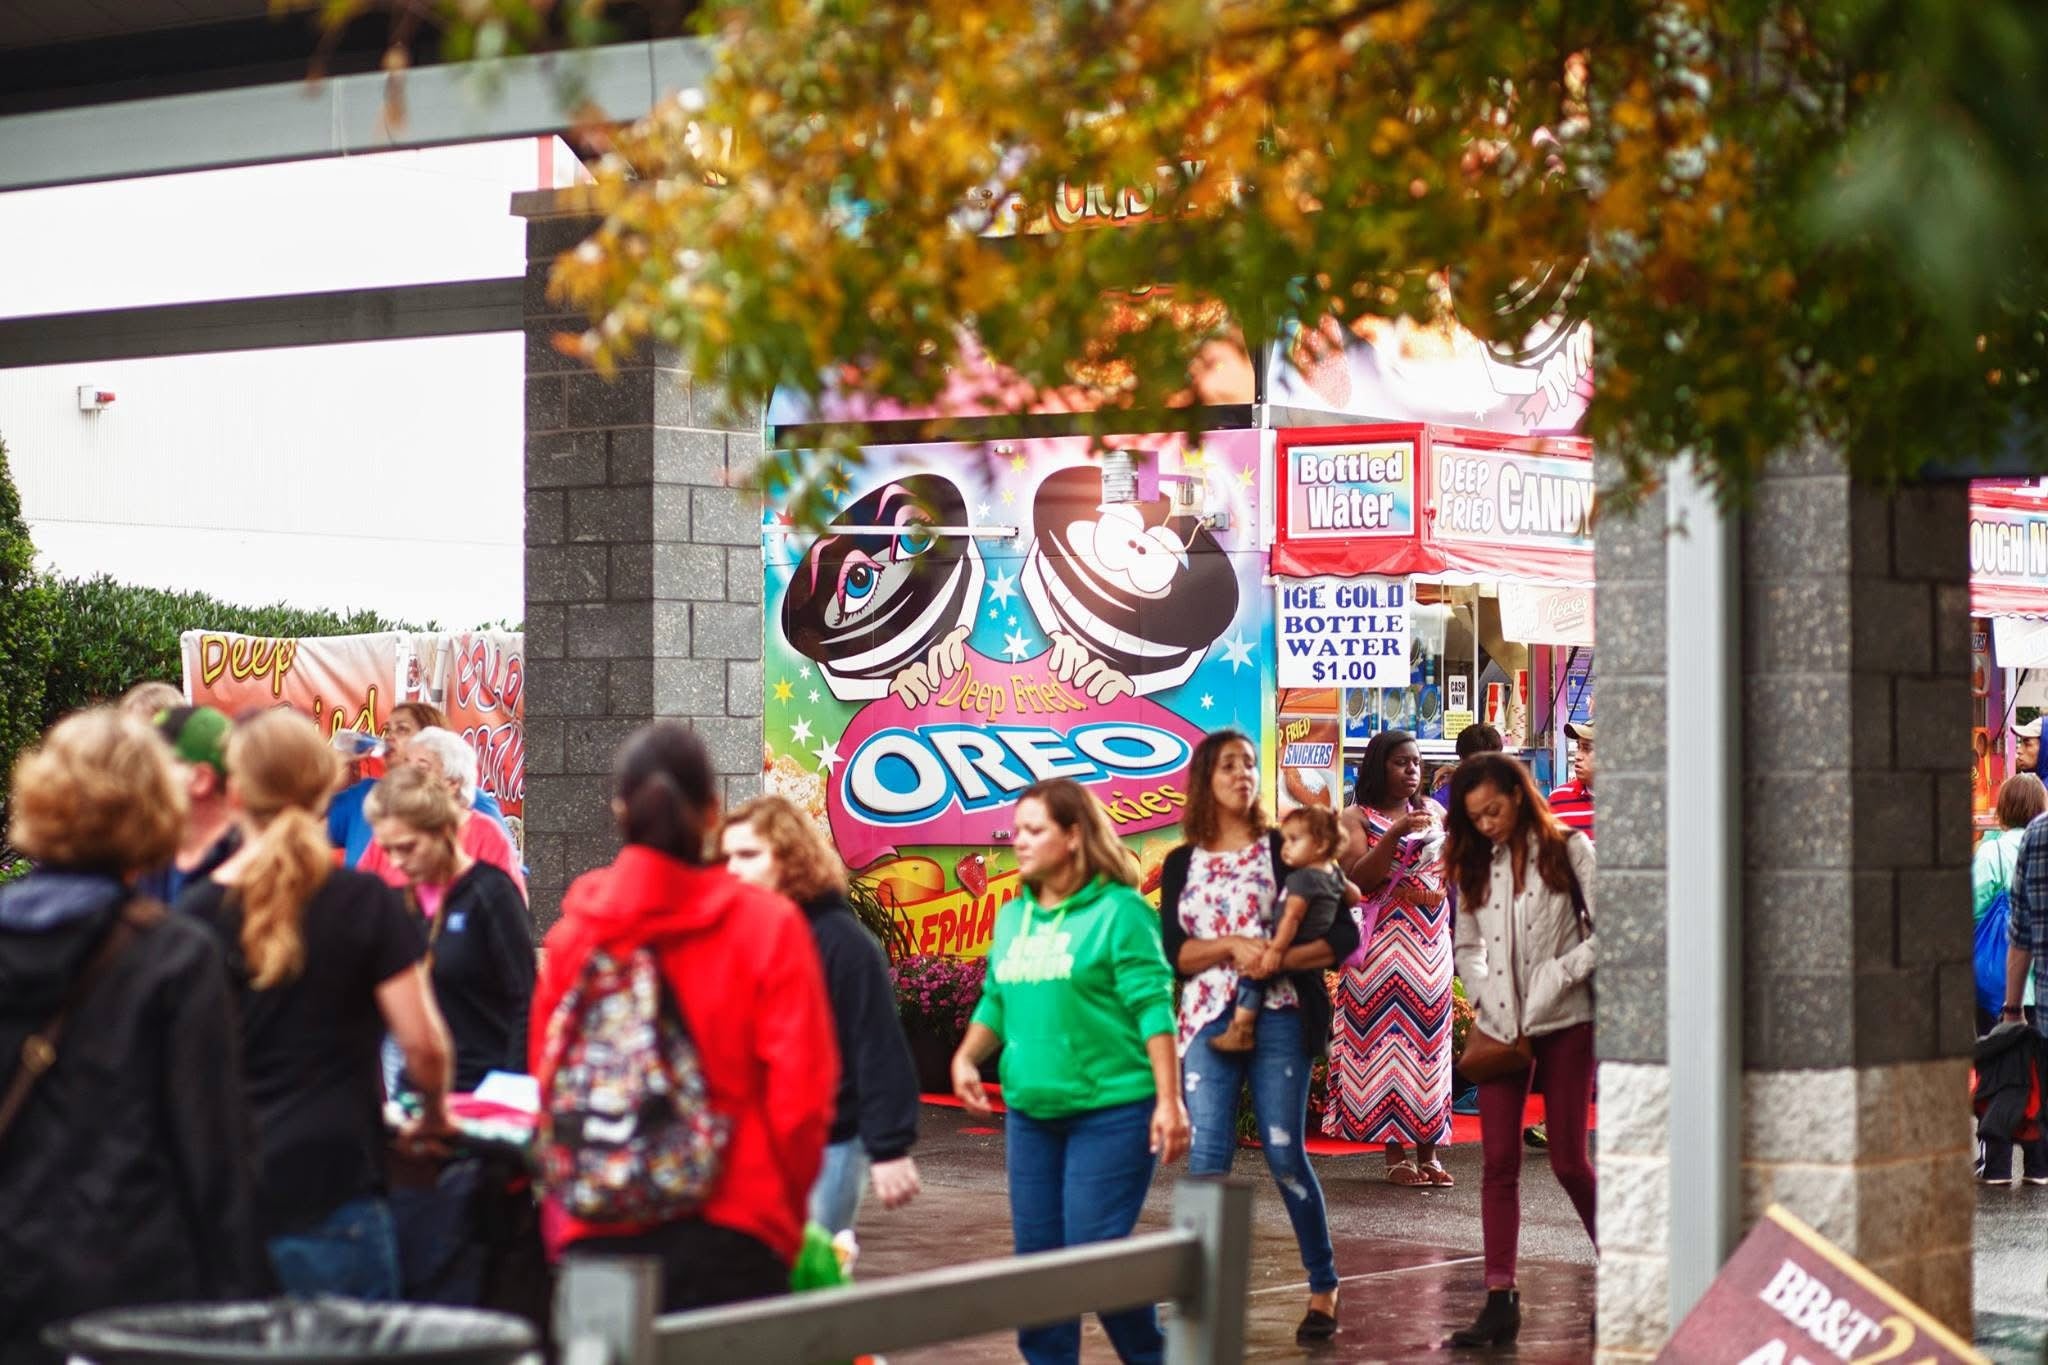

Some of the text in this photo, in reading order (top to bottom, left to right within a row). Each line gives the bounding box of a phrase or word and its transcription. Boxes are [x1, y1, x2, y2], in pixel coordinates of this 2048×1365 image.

[1298, 451, 1404, 485] Bottled
[1440, 455, 1490, 495] DEEP
[1307, 486, 1394, 530] Water
[1440, 492, 1496, 534] FRIED
[1498, 461, 1594, 536] CANDY
[1969, 519, 2024, 576] OUGH
[1283, 582, 1404, 609] ICE COLD
[1284, 615, 1404, 634] BOTTLE
[200, 634, 297, 697] Deep
[1286, 638, 1402, 657] WATER
[935, 661, 1088, 723] Deep Fried
[1312, 661, 1376, 683] $1.00
[1450, 681, 1466, 692] CASH
[1451, 694, 1465, 705] ONLY
[1285, 716, 1311, 744] FRIED
[846, 724, 1187, 816] OREO
[1284, 744, 1333, 766] SNICKERS
[1103, 784, 1188, 824] kies
[1759, 1257, 1882, 1361] BB&T
